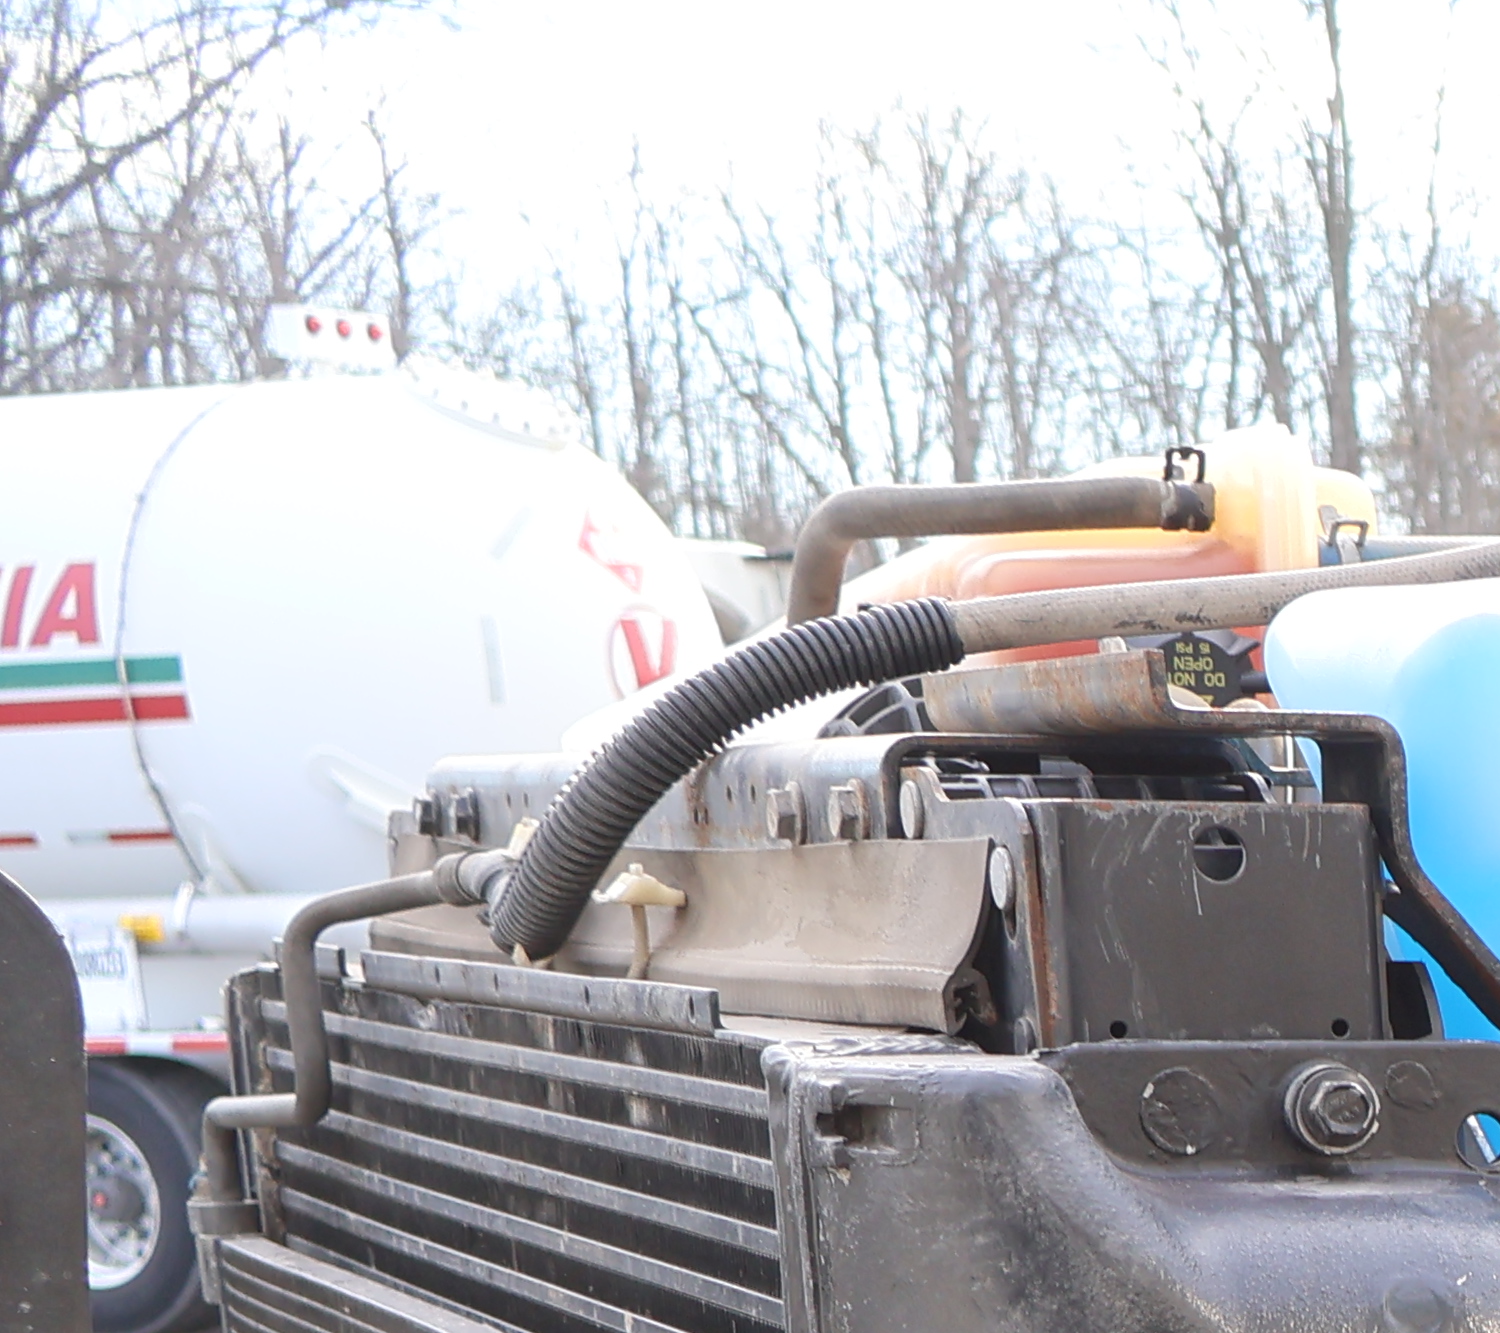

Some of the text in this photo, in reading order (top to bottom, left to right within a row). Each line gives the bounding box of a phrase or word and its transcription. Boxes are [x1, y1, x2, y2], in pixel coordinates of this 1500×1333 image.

[0, 562, 99, 647] IA
[1173, 655, 1214, 672] OPEN
[1204, 671, 1225, 688] DO
